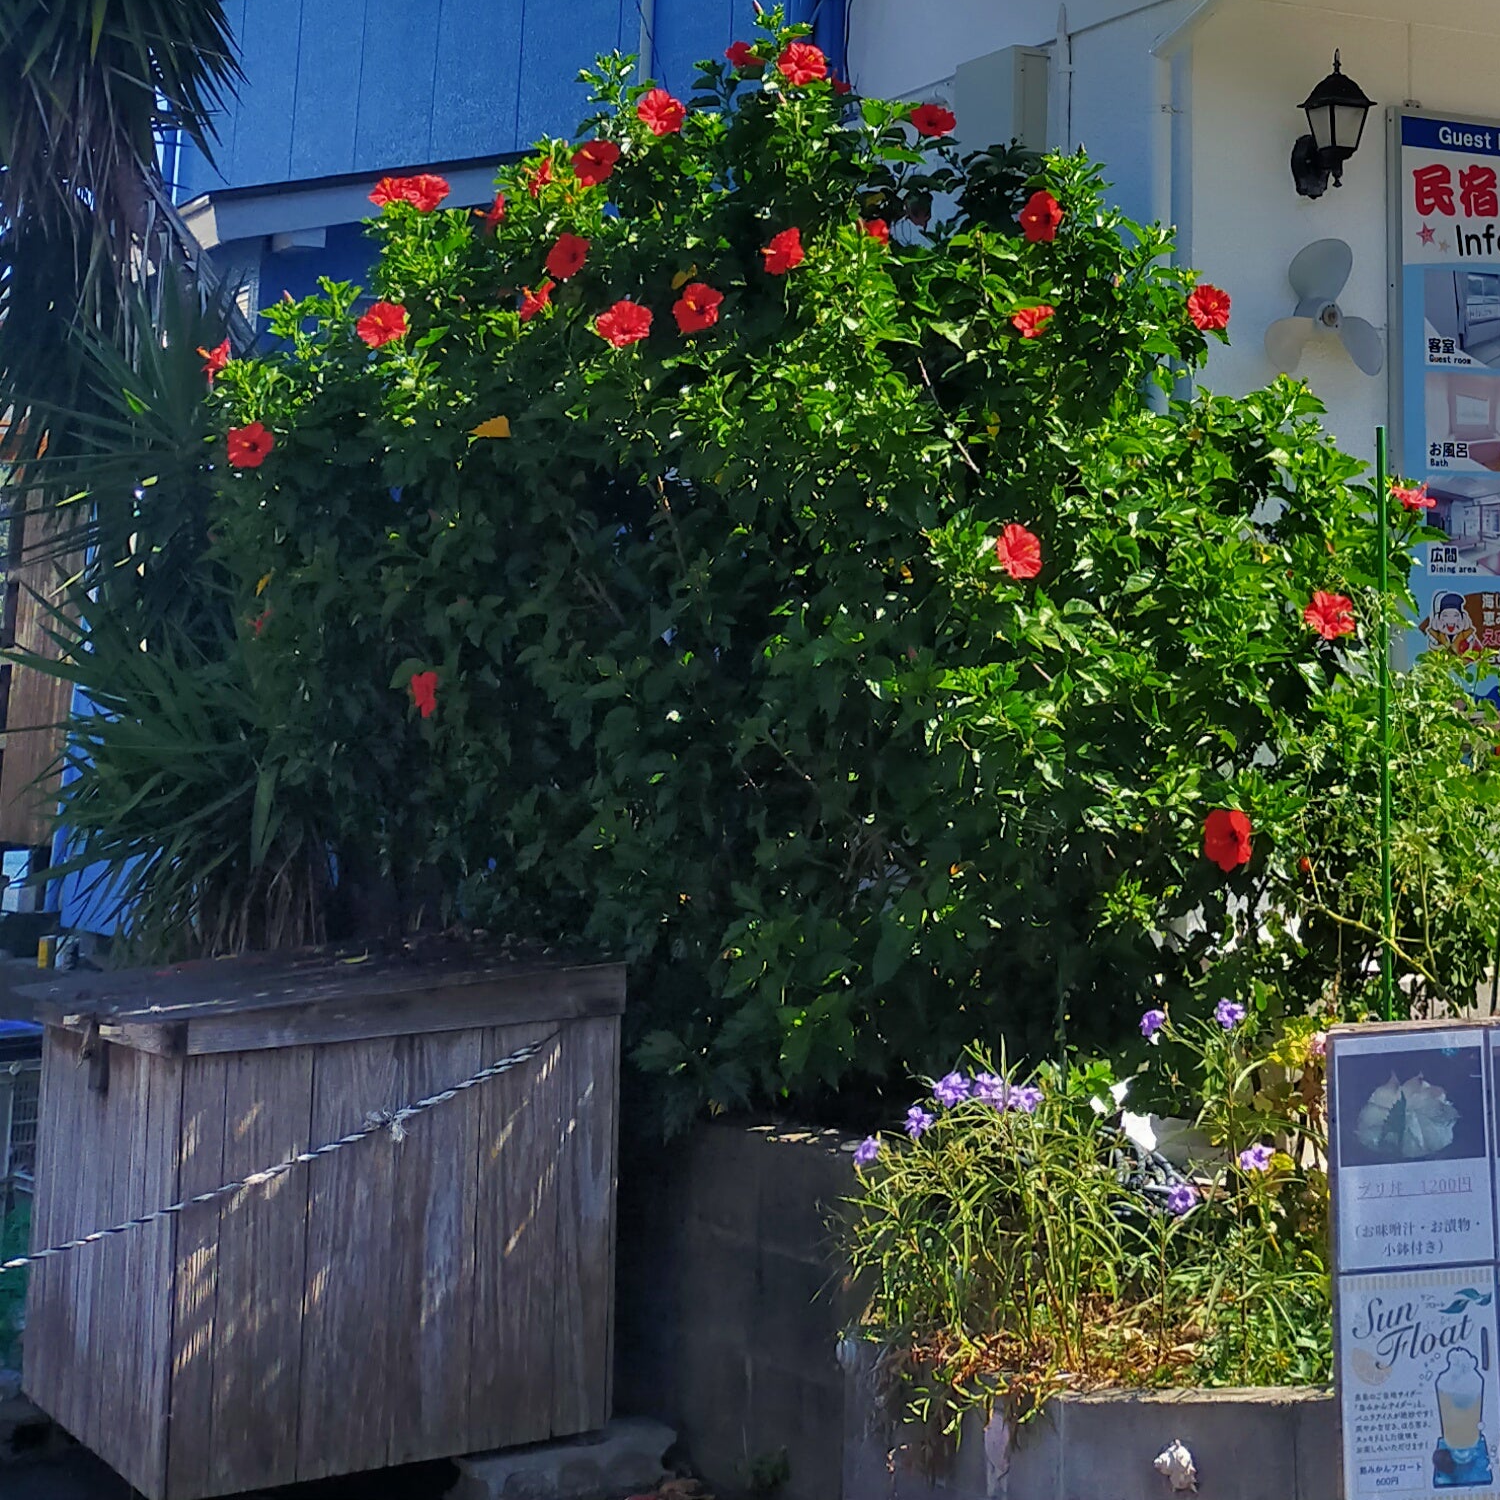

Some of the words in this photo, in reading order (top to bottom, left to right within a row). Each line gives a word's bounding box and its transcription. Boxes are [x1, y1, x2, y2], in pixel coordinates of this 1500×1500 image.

[1438, 126, 1492, 151] Guest
[1428, 338, 1455, 354] 客室
[1429, 354, 1451, 364] Guest
[1454, 357, 1472, 365] room
[1429, 442, 1468, 458] お風呂
[1430, 458, 1449, 467] Bath
[1430, 547, 1458, 563] 広間
[1431, 564, 1455, 574] Dining
[1459, 565, 1477, 574] area
[1352, 1297, 1419, 1339] Sun
[1375, 1314, 1474, 1370] Float
[1376, 1476, 1399, 1486] 600円
